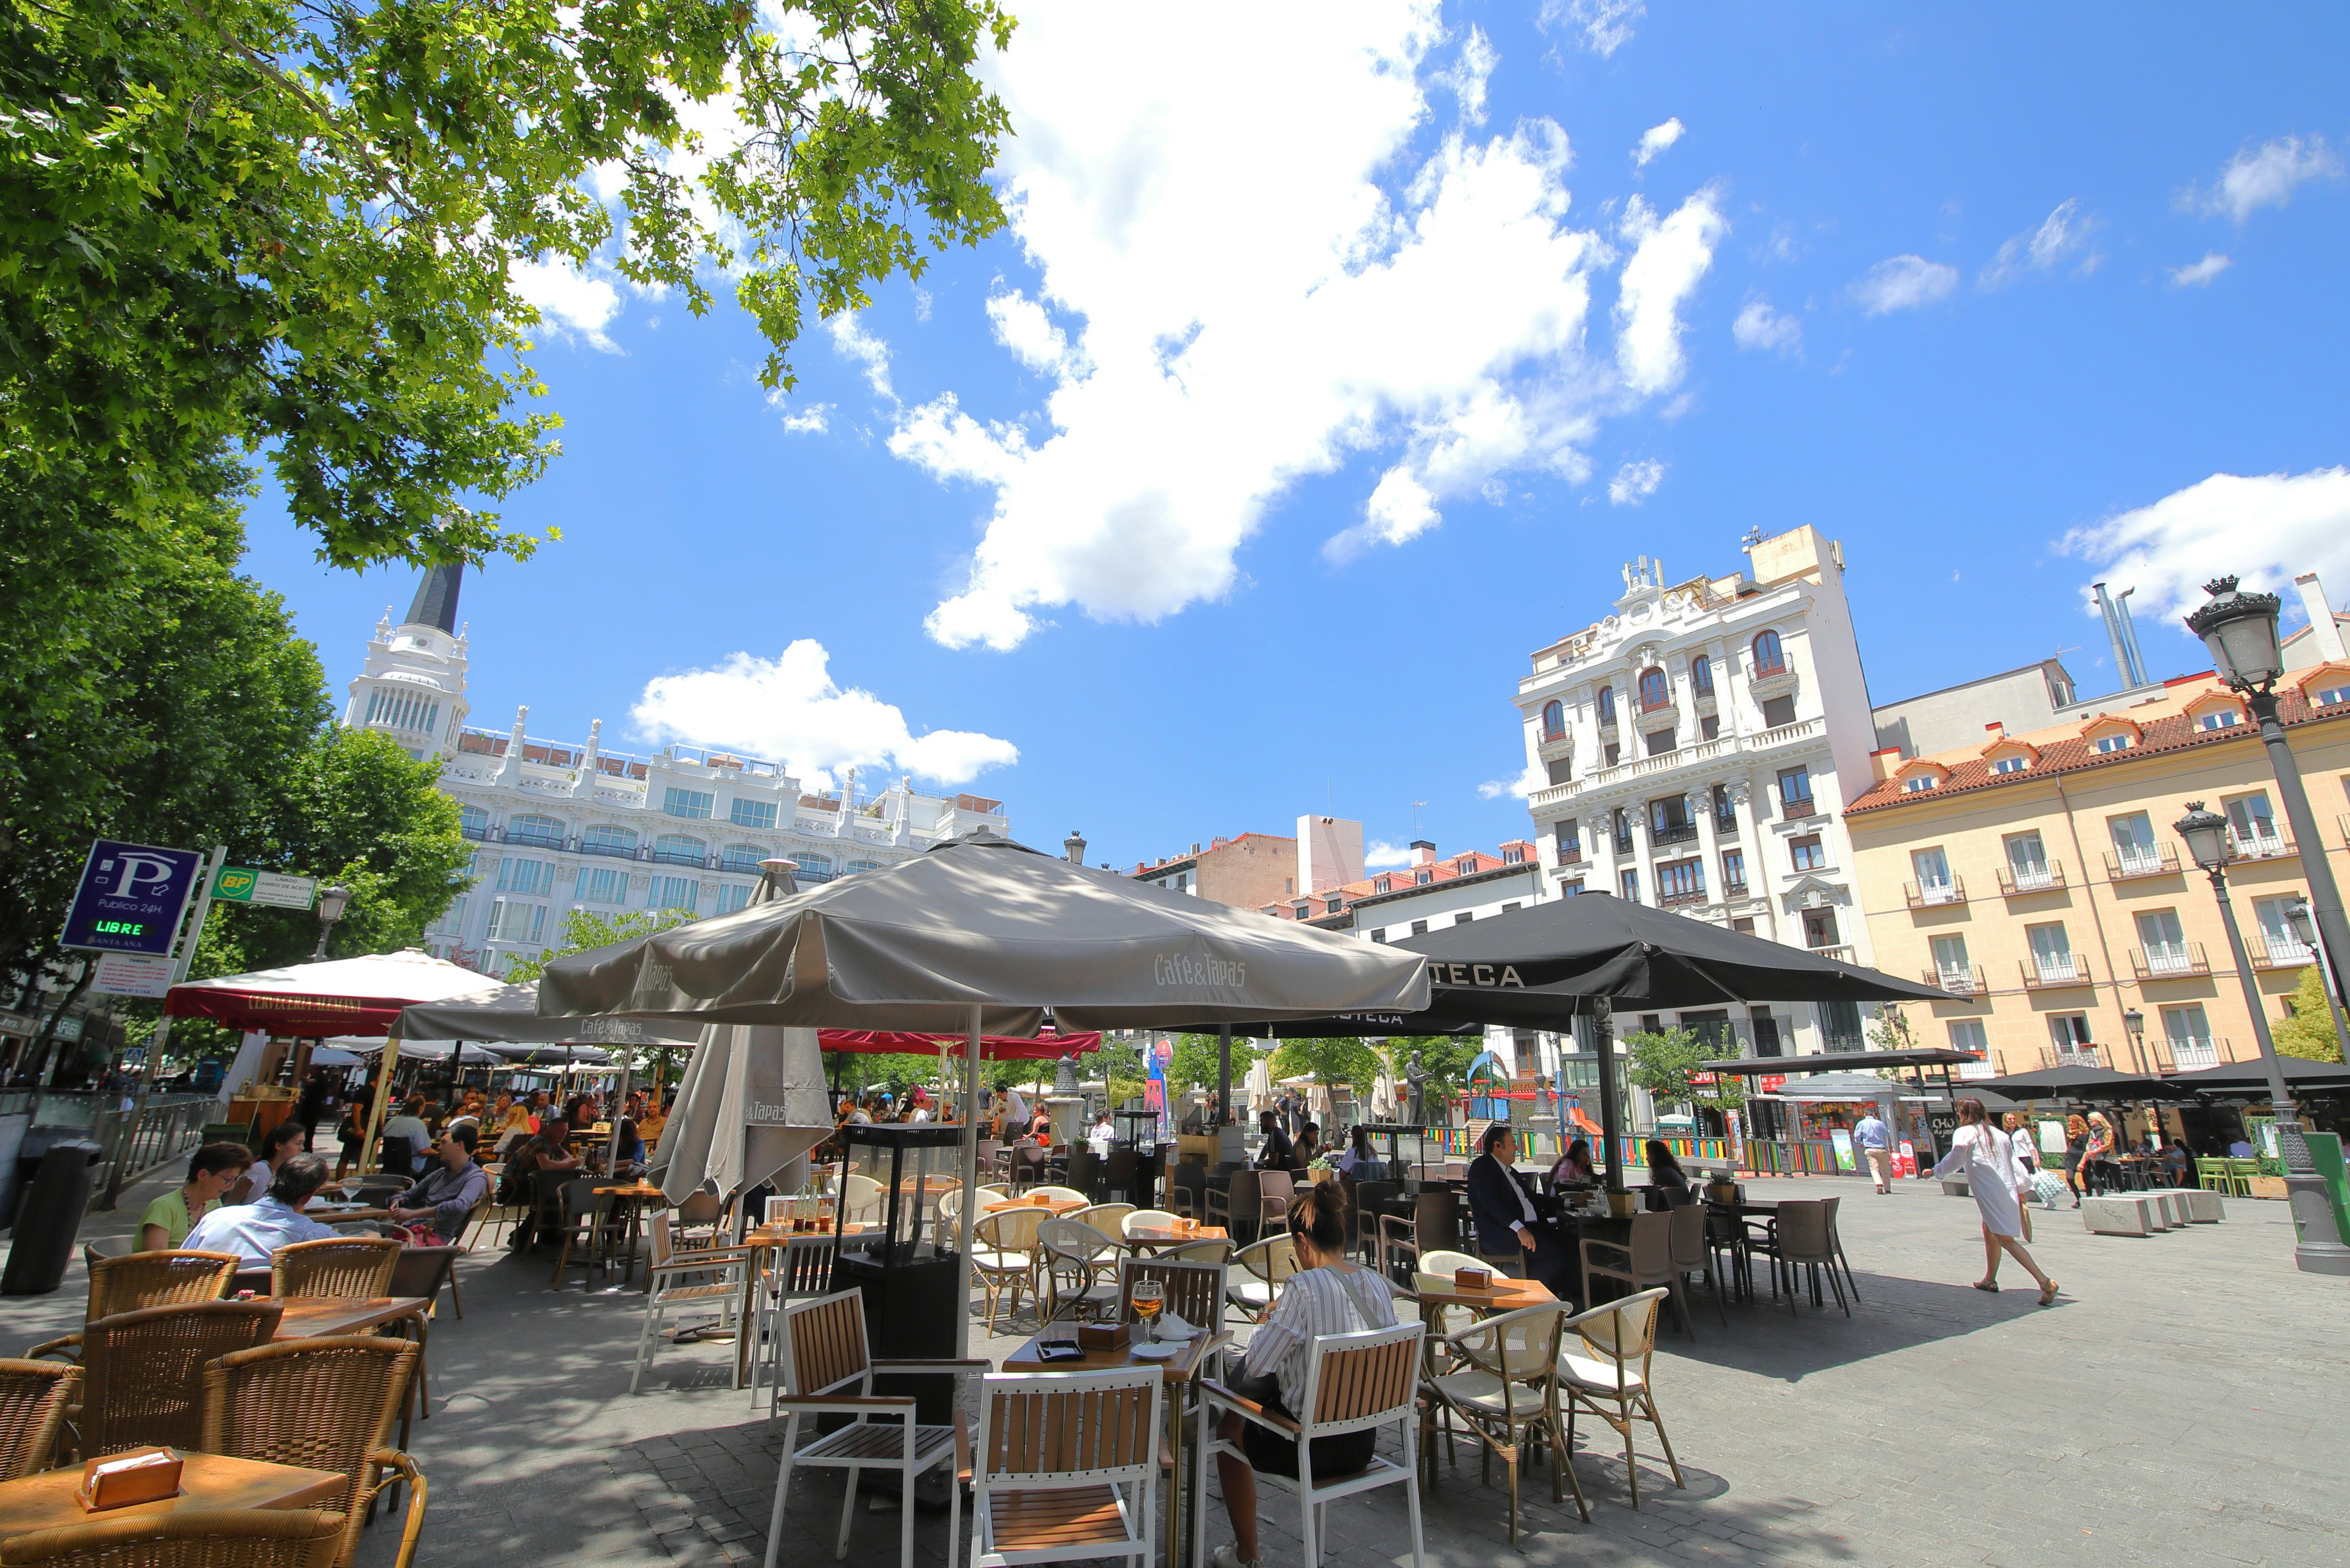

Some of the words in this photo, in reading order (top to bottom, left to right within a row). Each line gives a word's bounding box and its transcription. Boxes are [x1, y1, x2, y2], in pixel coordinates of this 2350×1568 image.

[105, 856, 172, 899] P
[222, 875, 250, 889] BP
[96, 920, 143, 935] LIBRE
